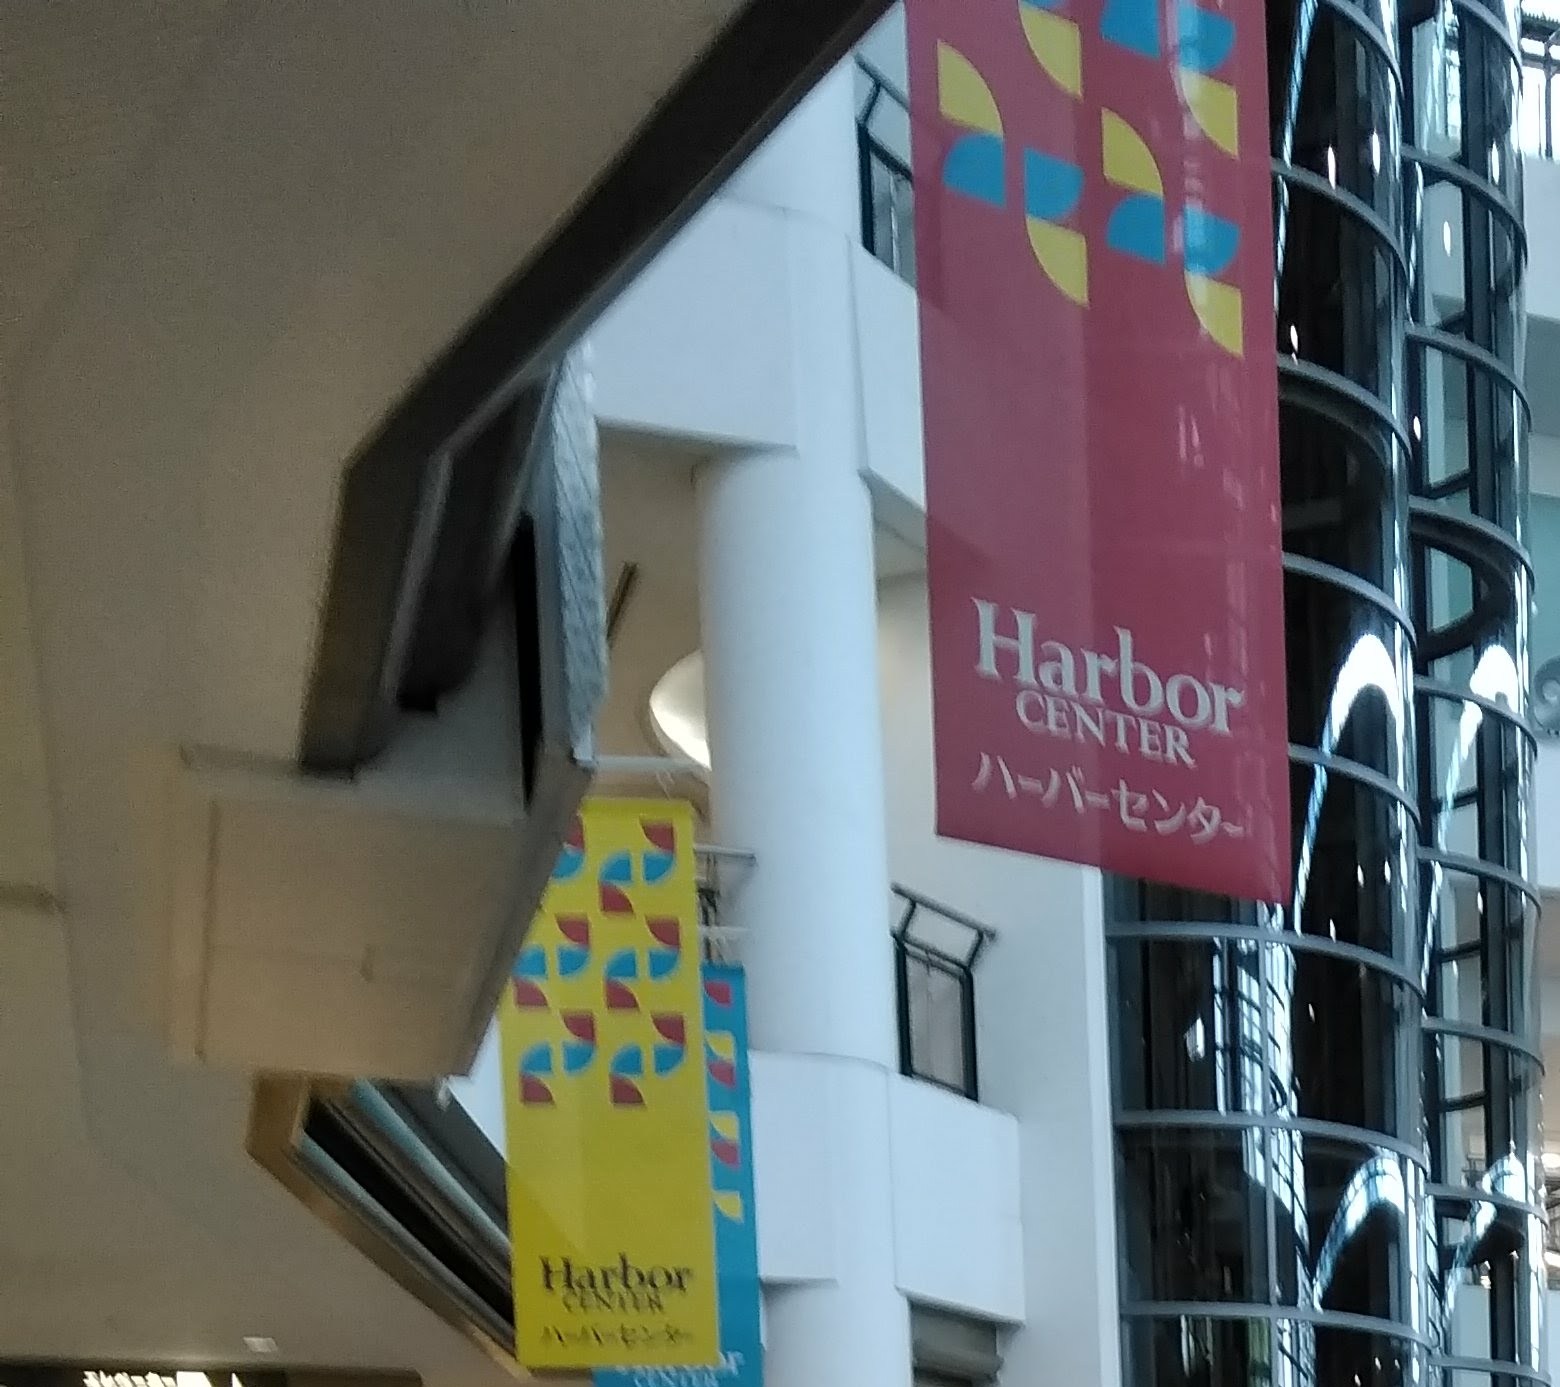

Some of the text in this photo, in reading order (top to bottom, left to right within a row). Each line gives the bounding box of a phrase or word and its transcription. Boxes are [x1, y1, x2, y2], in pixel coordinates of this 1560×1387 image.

[971, 597, 1244, 736] Harbor
[1016, 689, 1197, 768] CENTER
[972, 752, 1245, 844] ハーバーセンター
[539, 1252, 693, 1293] Harbor
[562, 1287, 664, 1315] CENTER
